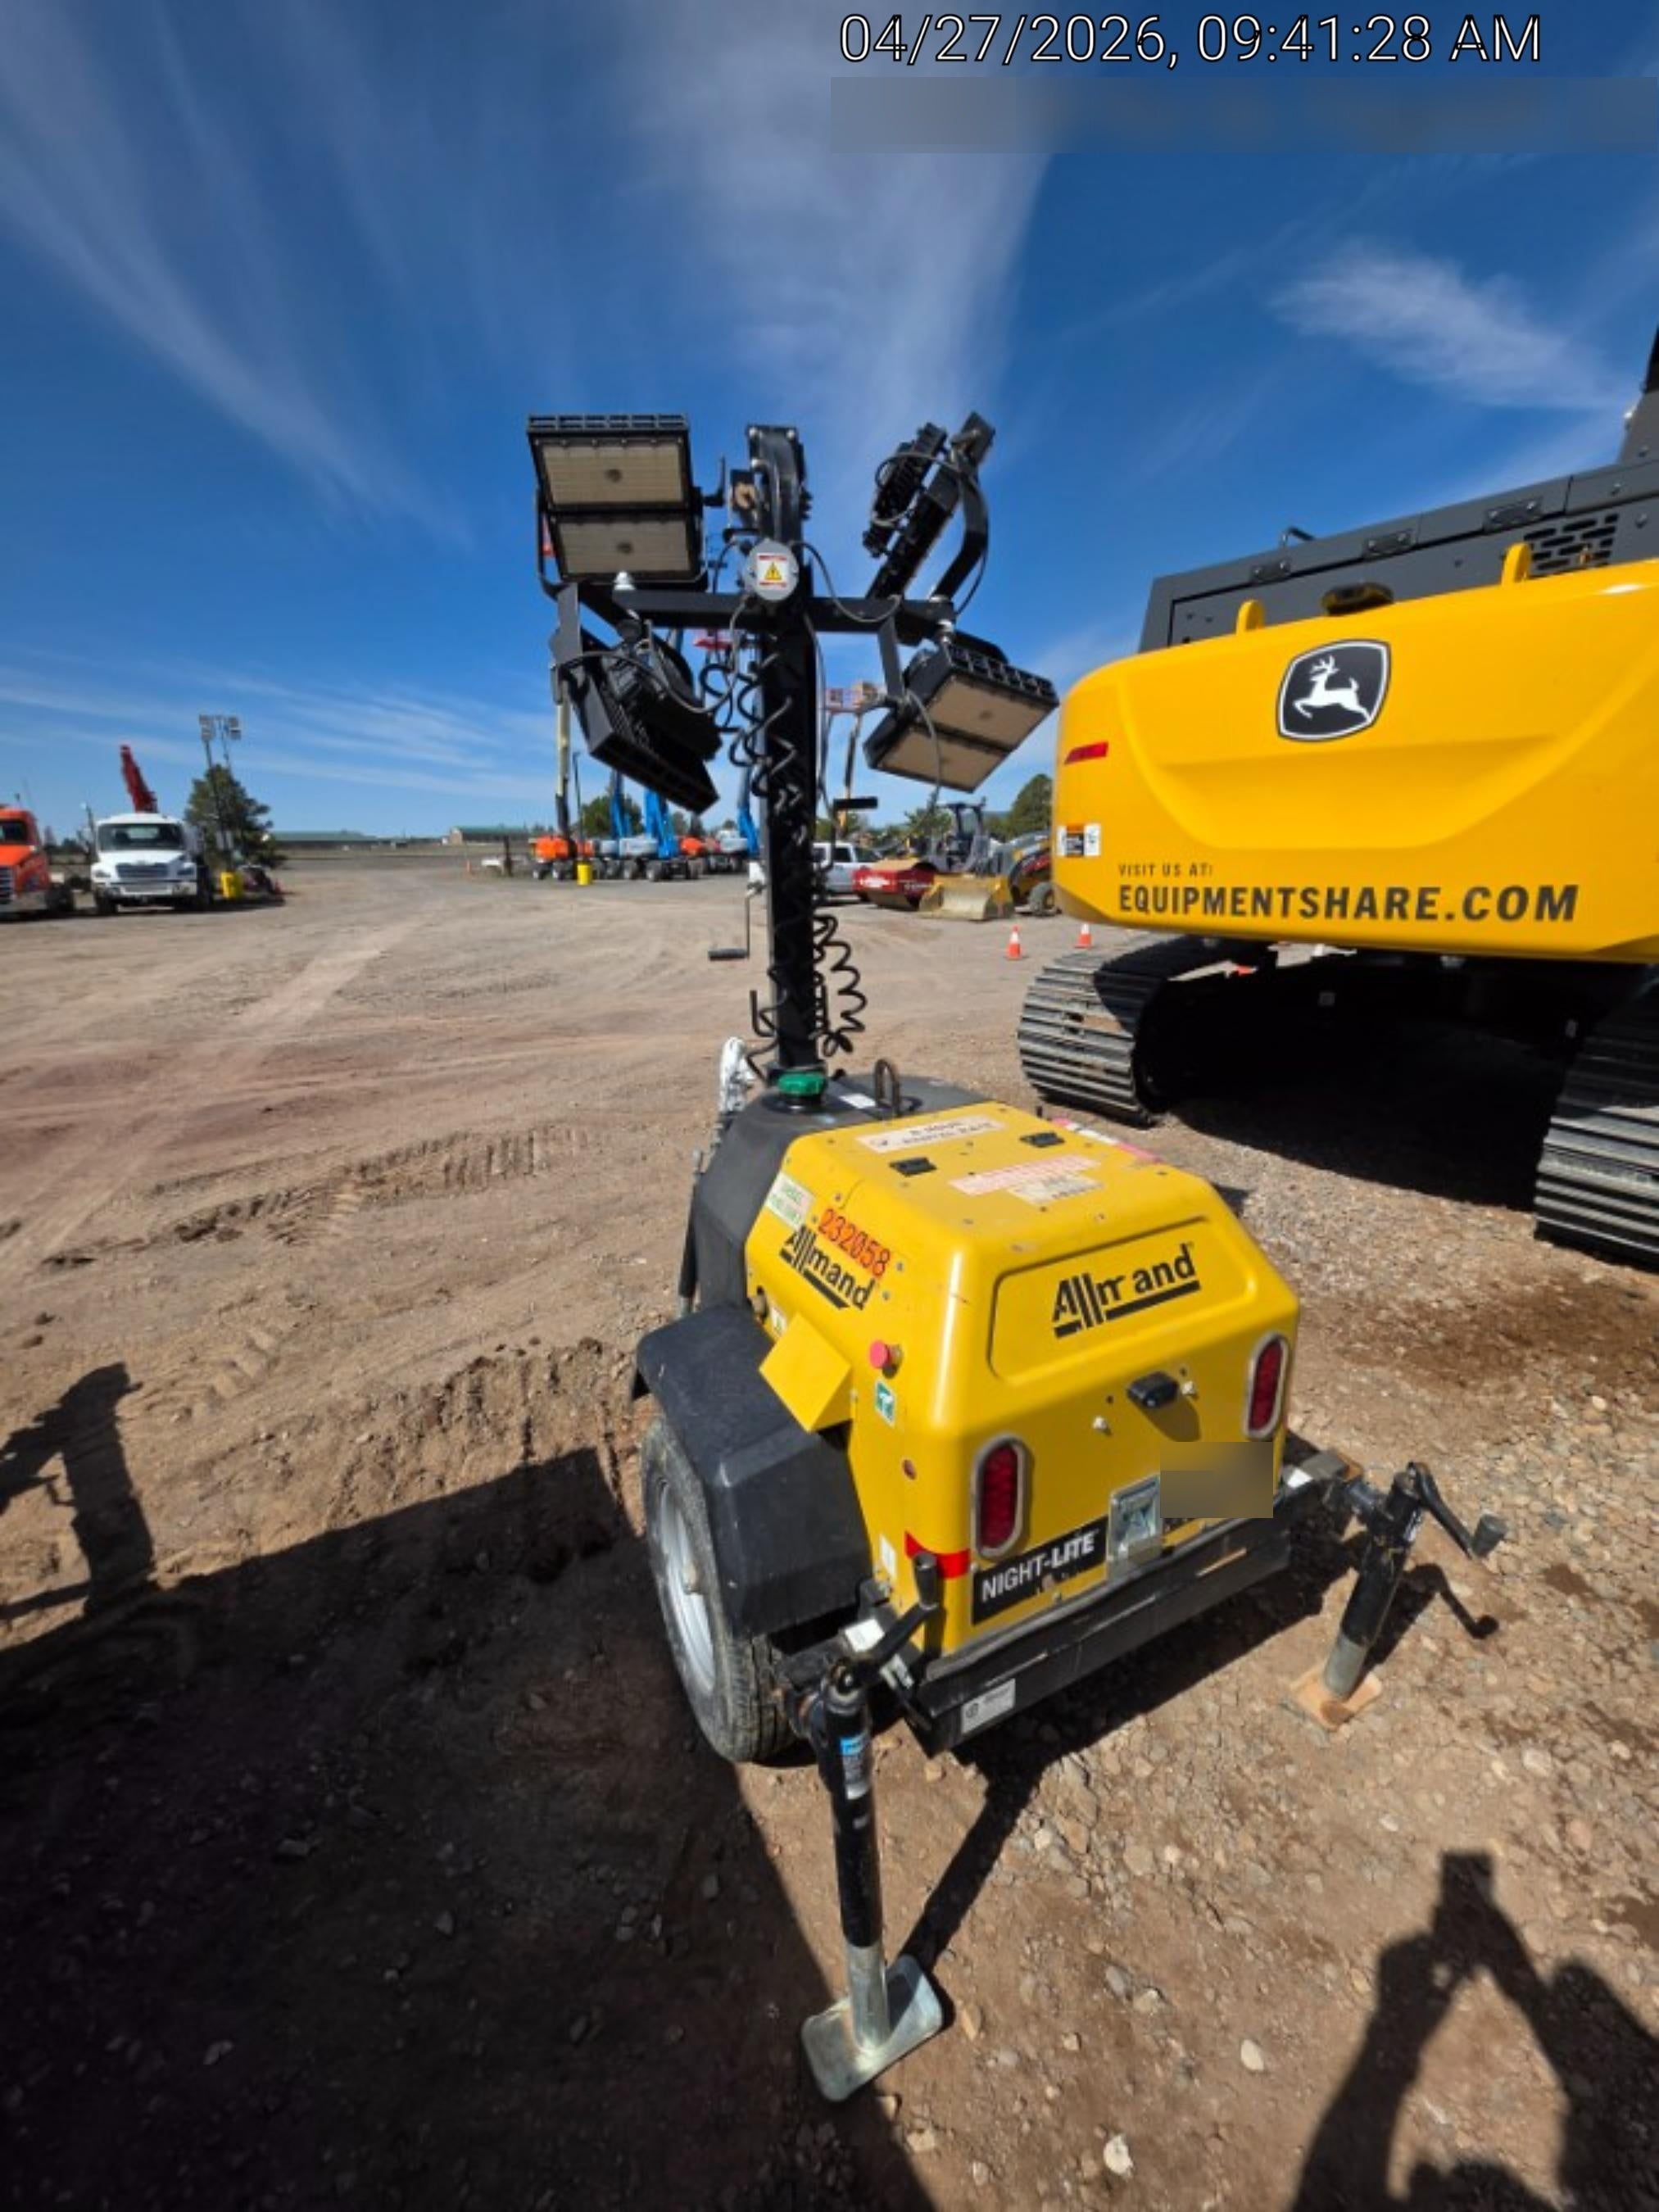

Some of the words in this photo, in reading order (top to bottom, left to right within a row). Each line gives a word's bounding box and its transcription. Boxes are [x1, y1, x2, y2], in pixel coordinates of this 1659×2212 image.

[1119, 863, 1155, 877] VISIT
[1162, 863, 1181, 877] US
[1119, 884, 1578, 922] EQUIPMENTSHARE.COM
[781, 1224, 875, 1310] Allmand
[818, 1208, 891, 1277] 232058
[981, 1530, 1096, 1603] NIGHT-LITE
